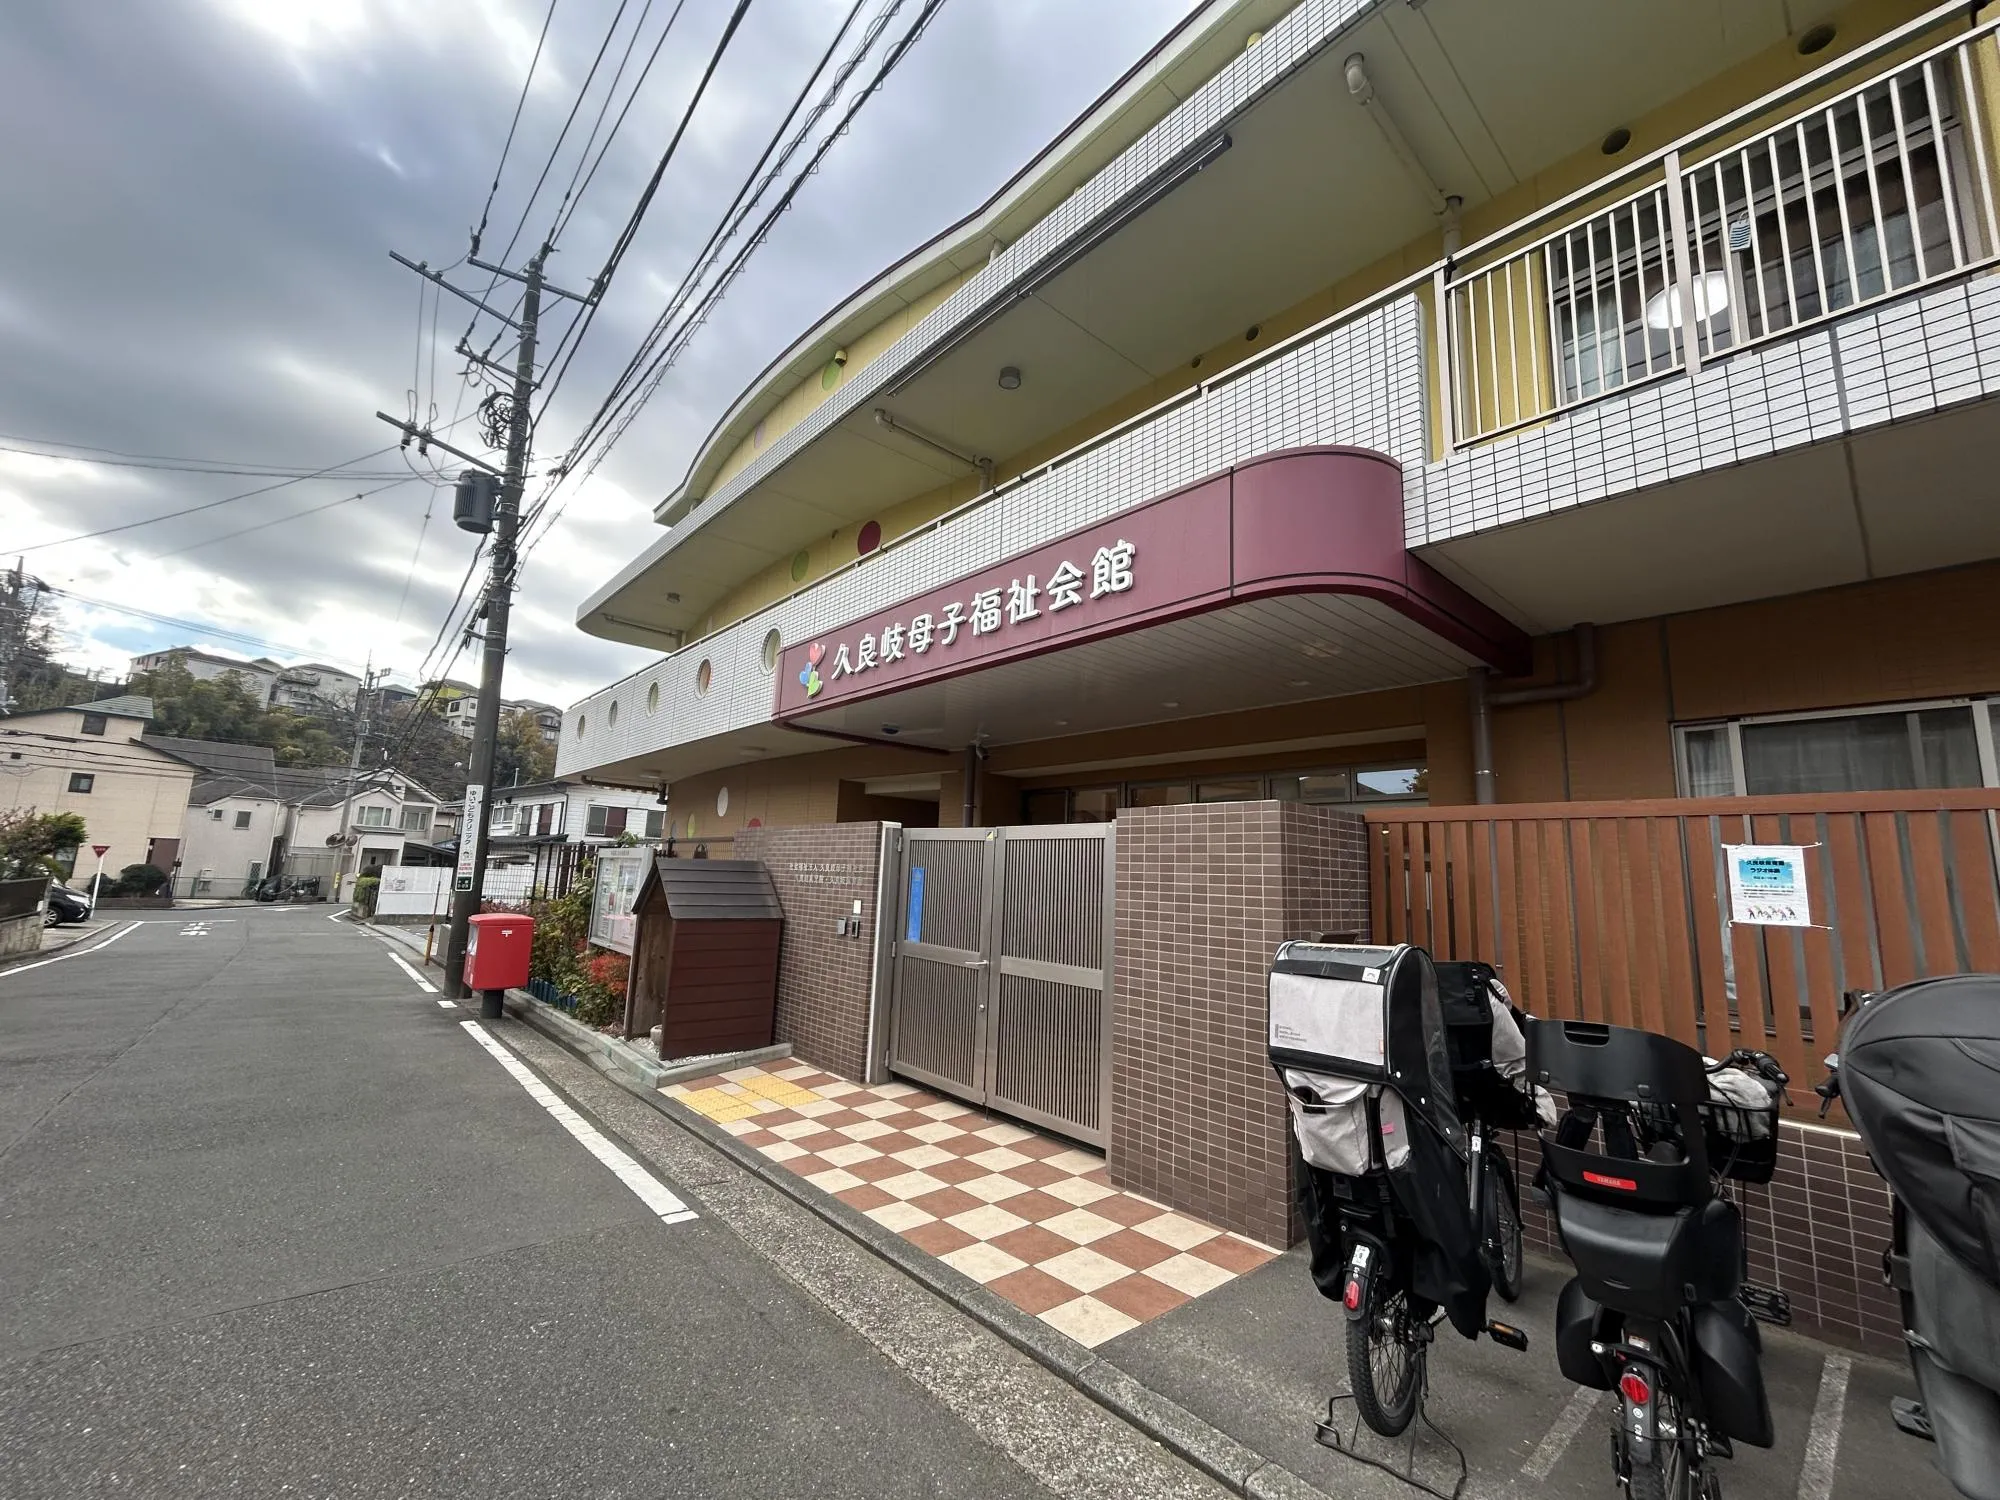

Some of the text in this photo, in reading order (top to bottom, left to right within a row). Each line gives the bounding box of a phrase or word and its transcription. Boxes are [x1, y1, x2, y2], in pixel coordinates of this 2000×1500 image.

[831, 539, 1137, 681] 久良岐母子福祉会館
